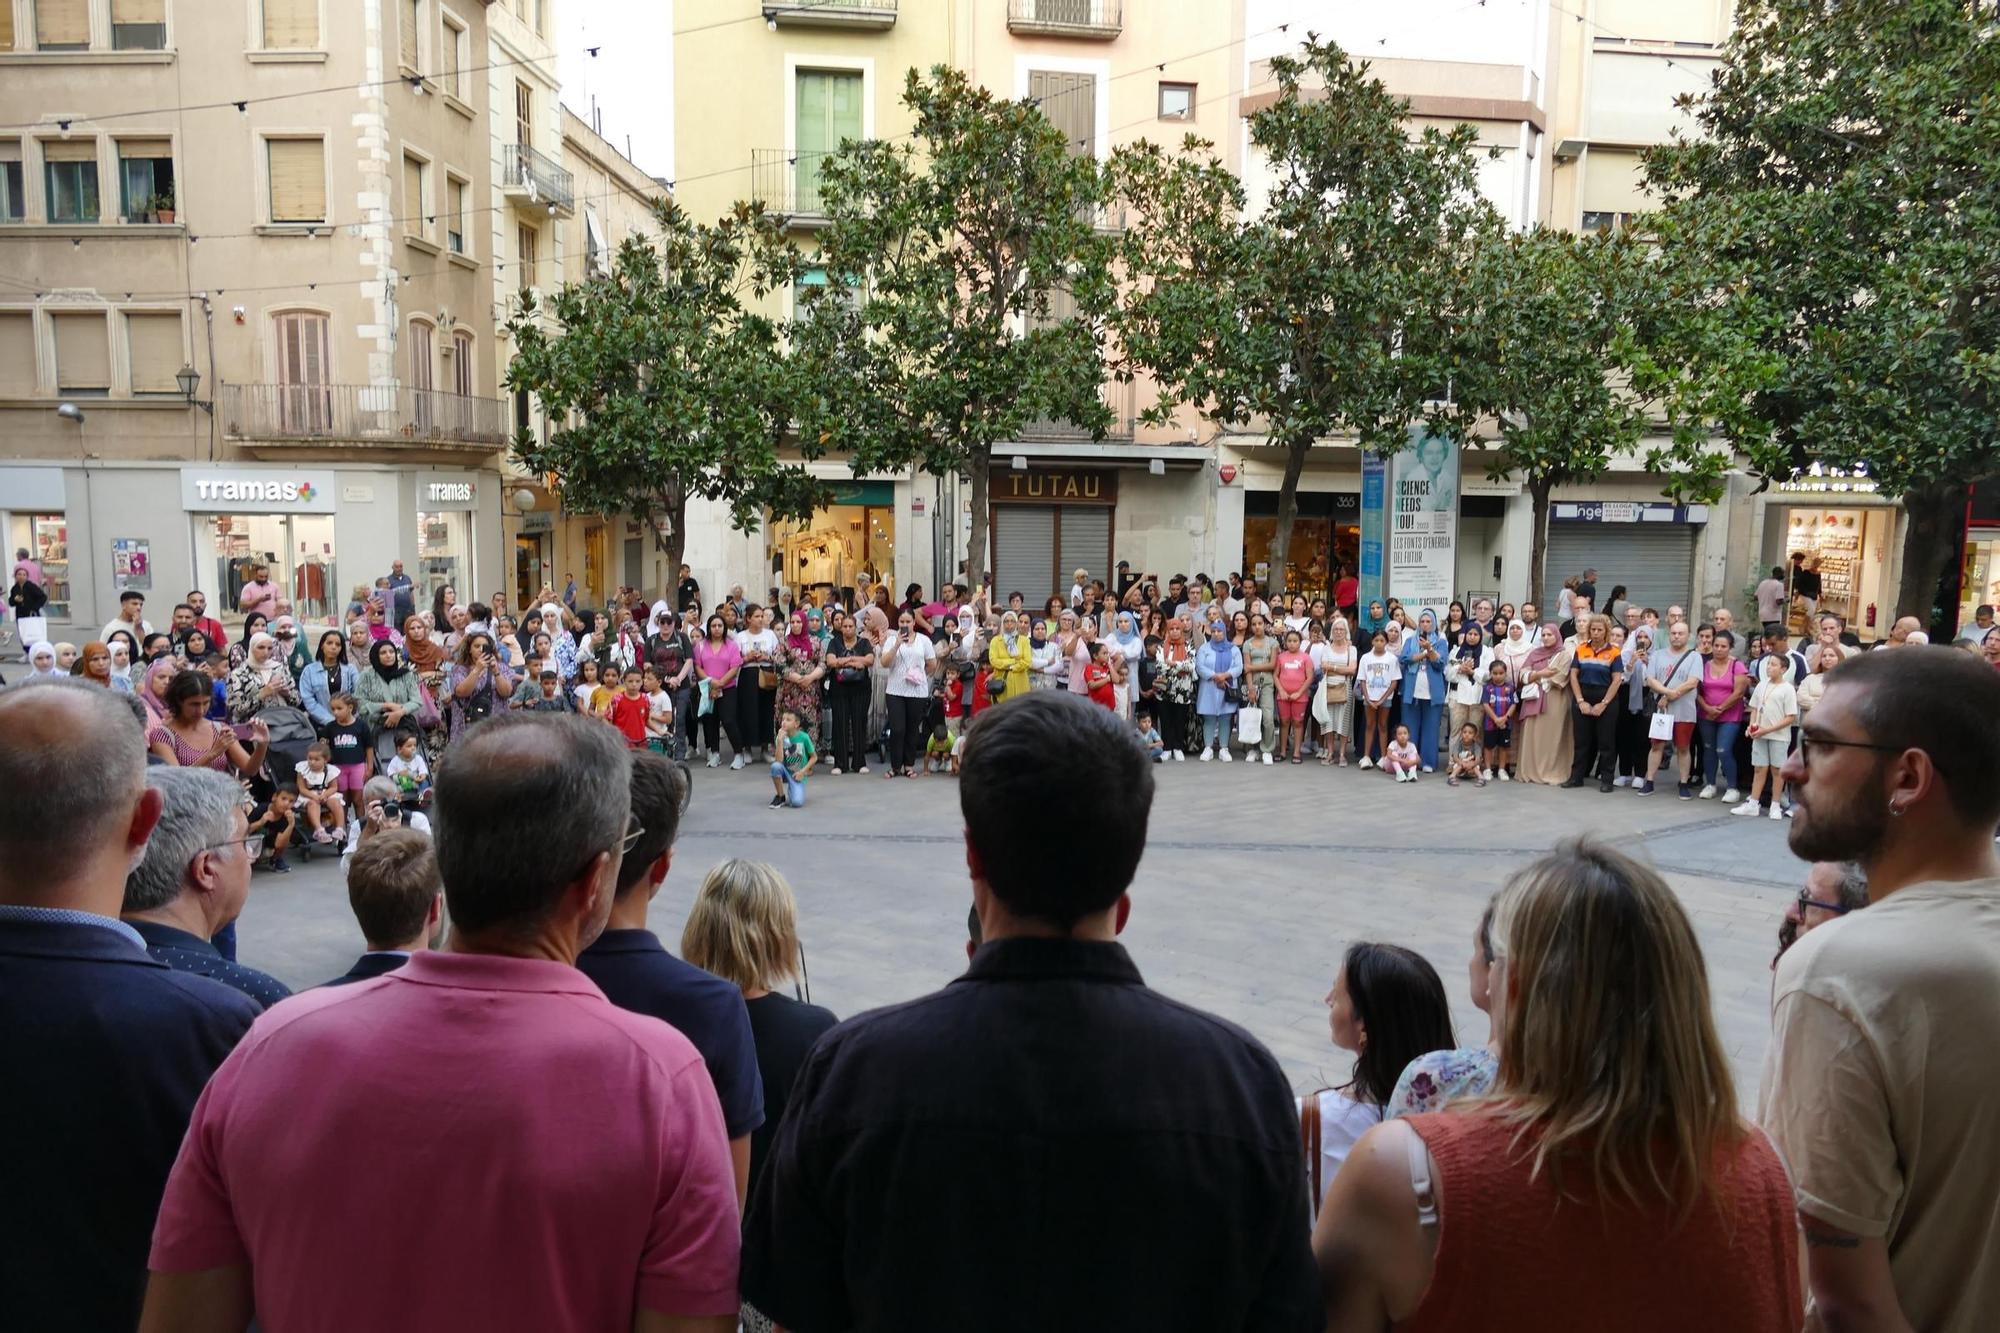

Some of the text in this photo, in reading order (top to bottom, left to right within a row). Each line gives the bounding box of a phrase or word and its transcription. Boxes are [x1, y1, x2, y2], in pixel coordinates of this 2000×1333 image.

[1008, 474, 1099, 497] TUTAU
[1396, 480, 1430, 496] SCIENCE
[1831, 483, 1848, 492] GO
[1853, 483, 1879, 493] SHO
[1336, 496, 1355, 508] 365
[1395, 497, 1421, 512] NEEDS
[1395, 514, 1414, 529] YOU!
[1393, 537, 1404, 549] LES
[1405, 536, 1422, 549] FONTS
[1393, 551, 1403, 564] DEL
[1404, 551, 1423, 563] FUTUR
